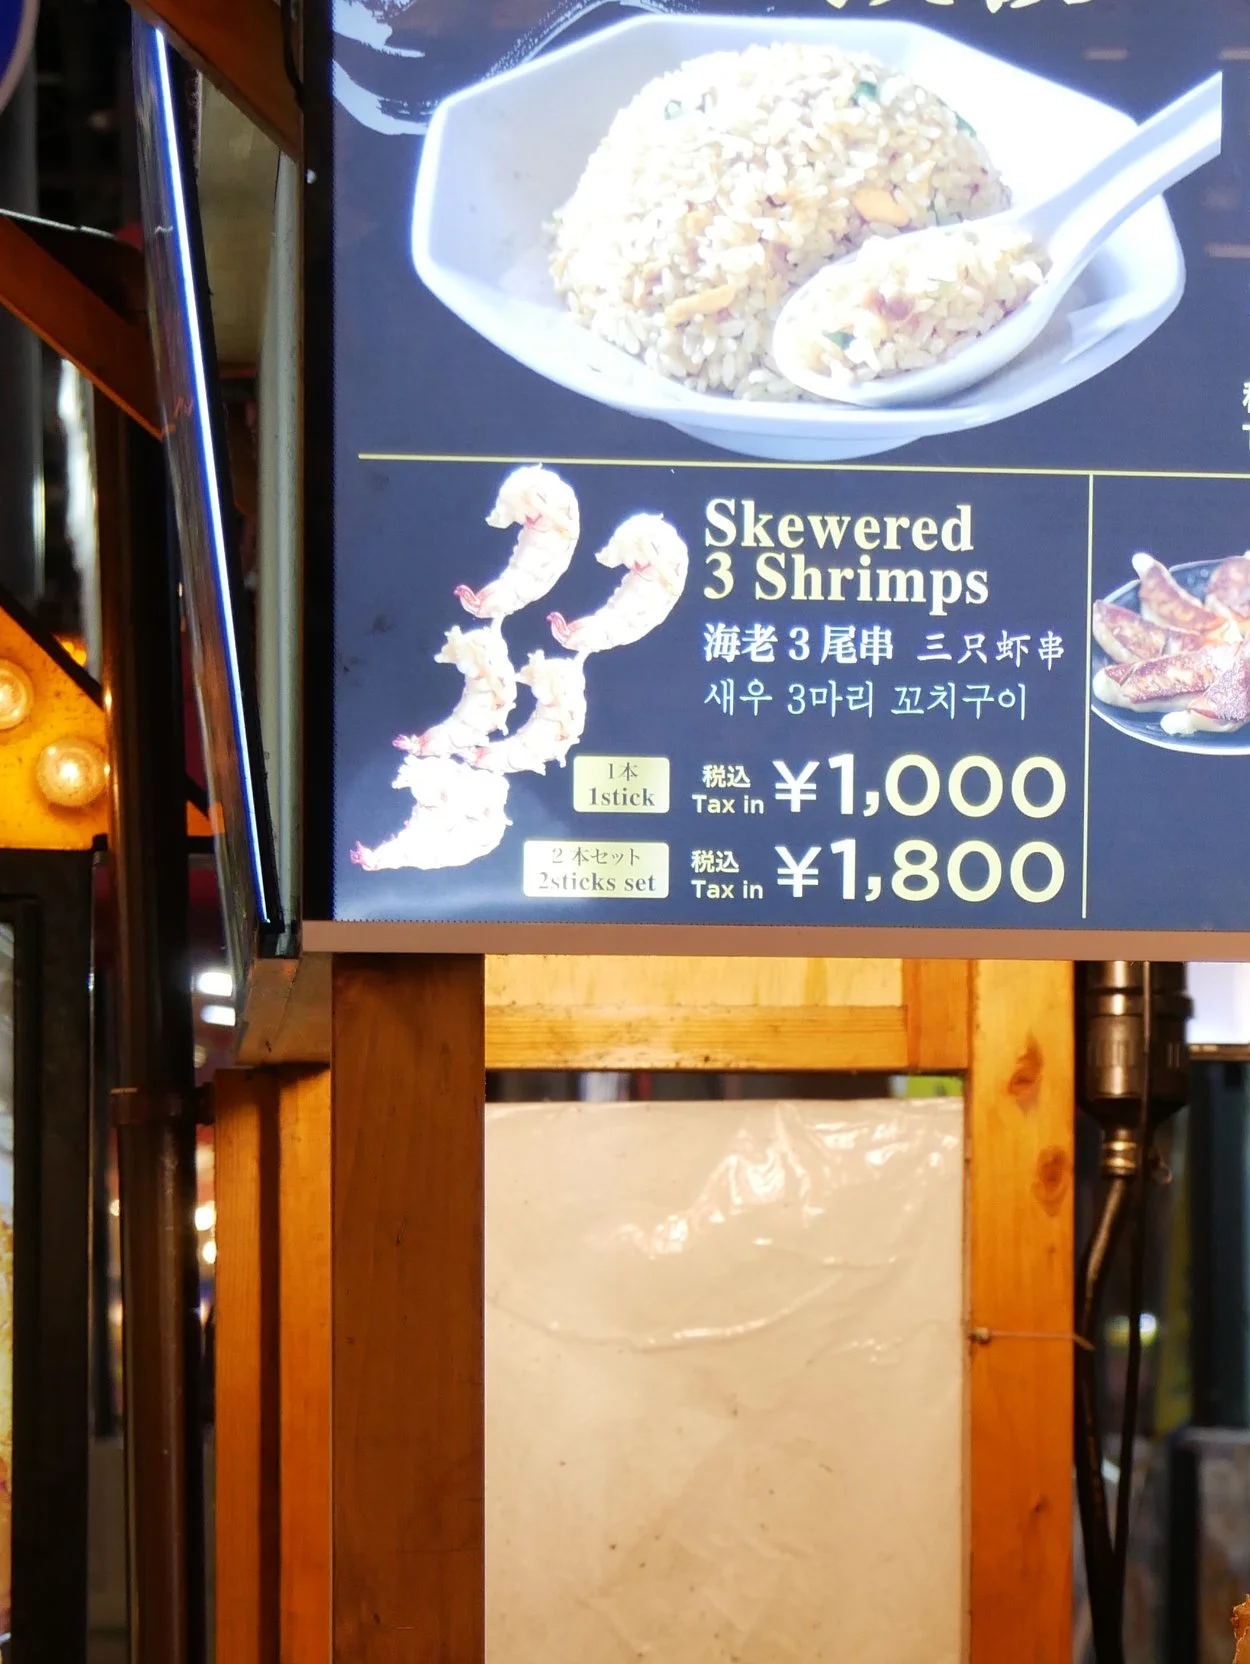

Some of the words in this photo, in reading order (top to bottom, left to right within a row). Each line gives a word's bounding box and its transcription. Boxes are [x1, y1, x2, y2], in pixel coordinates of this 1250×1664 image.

[704, 497, 974, 552] Skewered
[703, 552, 734, 600] 3
[755, 552, 989, 616] Shrimps
[704, 678, 773, 716] 새우
[787, 680, 873, 718] 3마리
[890, 682, 1026, 720] 꼬치구이
[608, 762, 638, 781] 1本
[702, 764, 751, 789] 税込
[589, 787, 655, 806] 1stick
[772, 753, 1067, 818] ¥1,000
[692, 794, 735, 814] Tax
[742, 794, 764, 815] in
[691, 849, 740, 874] 税込
[774, 838, 1066, 903] ¥1,800
[539, 872, 616, 891] 2sticks
[624, 874, 656, 891] set
[691, 879, 735, 899] Tax
[742, 878, 763, 900] in
